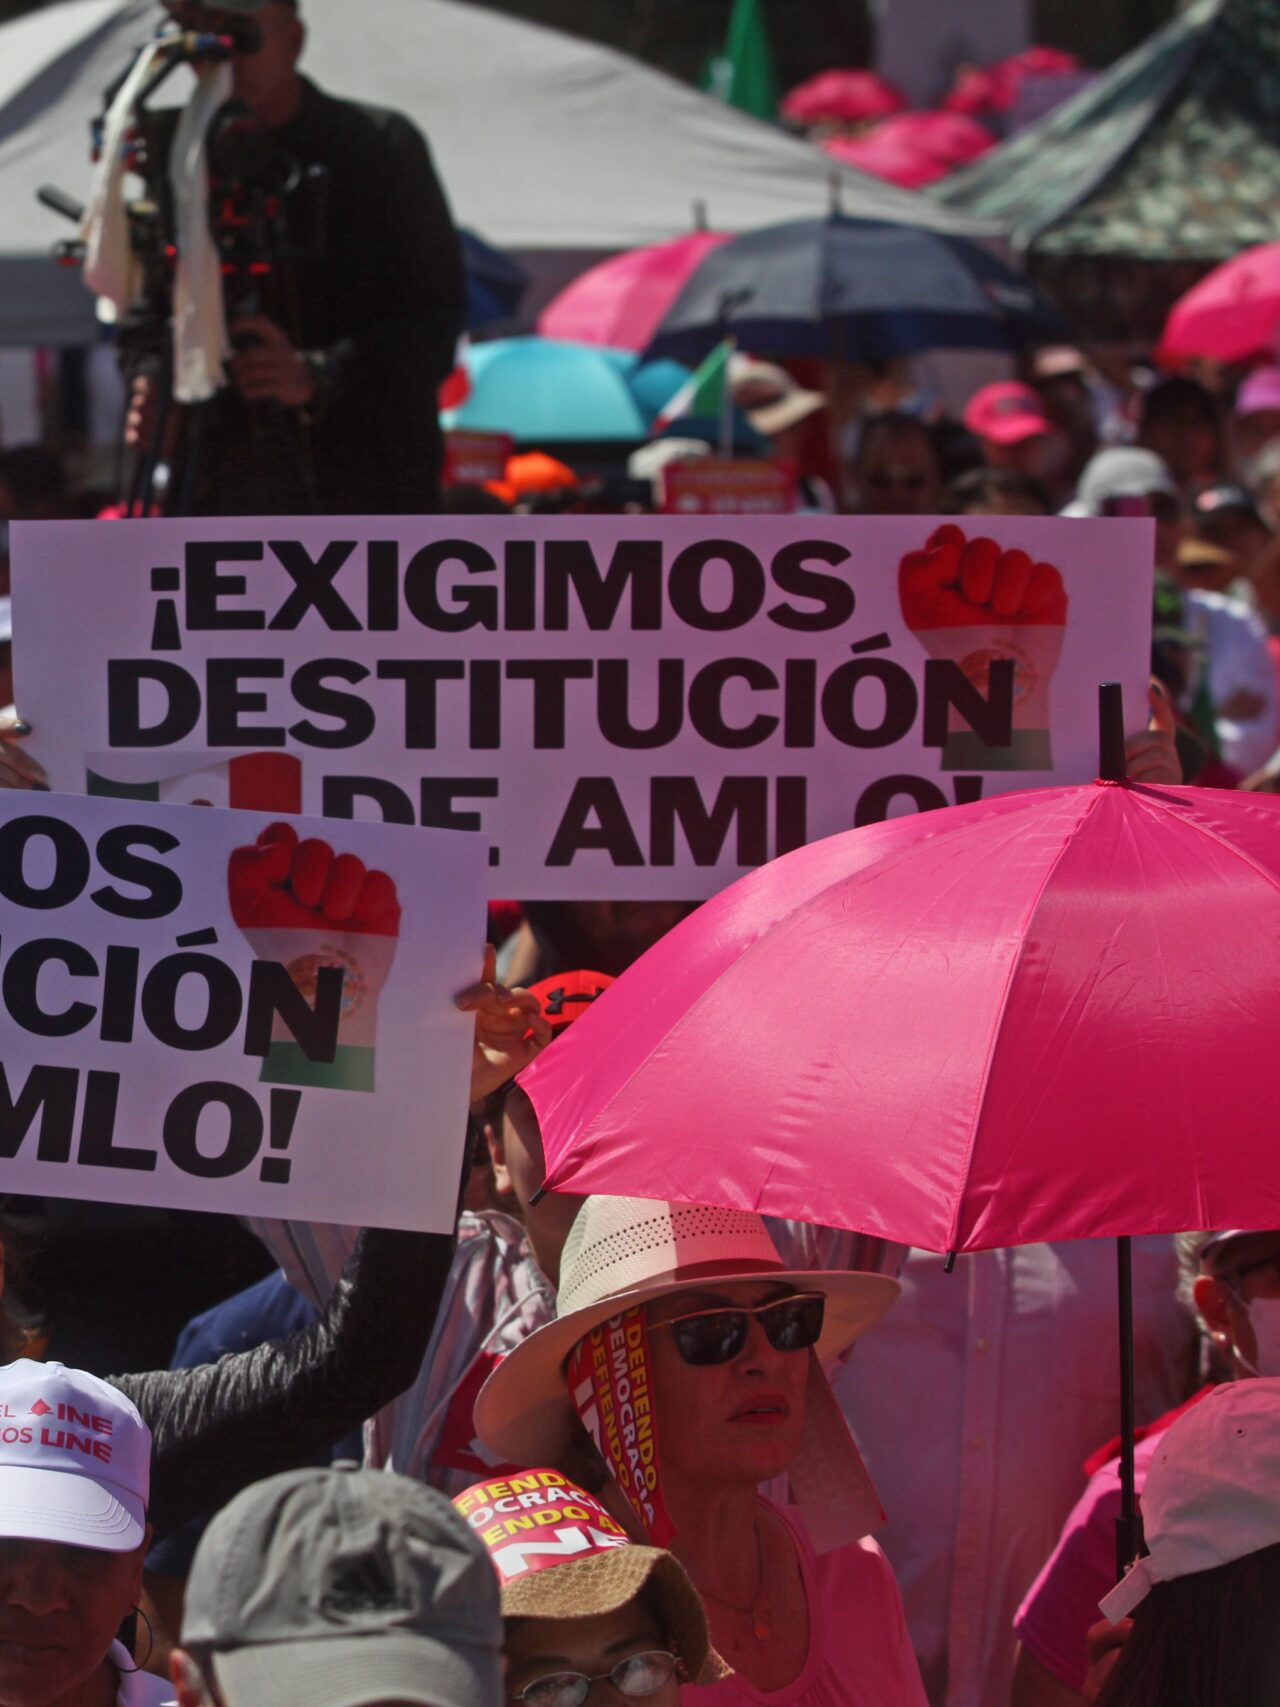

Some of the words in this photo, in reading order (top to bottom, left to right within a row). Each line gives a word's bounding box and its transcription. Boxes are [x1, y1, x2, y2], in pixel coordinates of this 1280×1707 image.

[151, 539, 856, 650] ¡EXIGIMOS
[108, 631, 1016, 748] DESTITUCIÓN
[57, 1402, 113, 1437] INE
[625, 1328, 658, 1491] DEFIENDO
